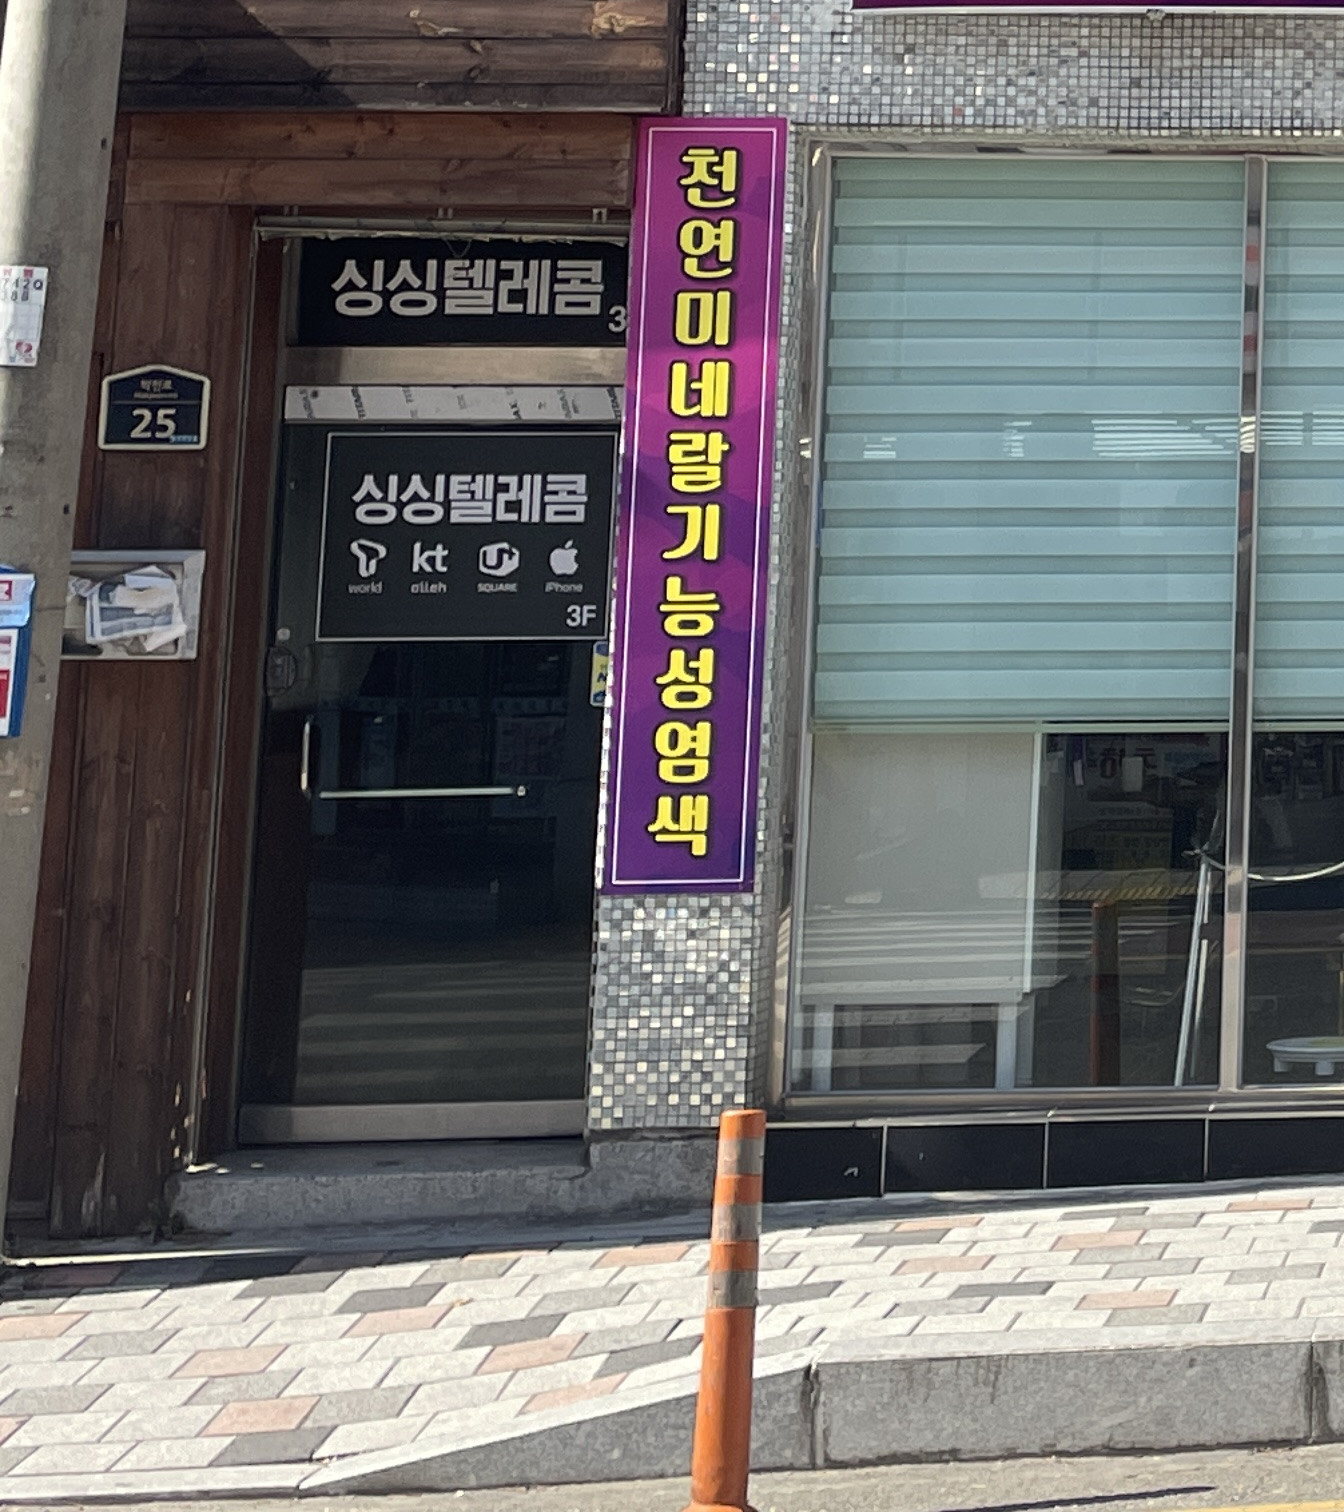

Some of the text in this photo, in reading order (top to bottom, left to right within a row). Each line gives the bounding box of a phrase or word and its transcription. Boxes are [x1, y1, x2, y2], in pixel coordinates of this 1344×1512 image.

[331, 259, 604, 318] 싱싱텔레콤
[130, 408, 176, 439] 25
[351, 473, 588, 525] 싱싱텔레콤
[647, 146, 740, 859] 천연미네랄기능성염색
[411, 541, 449, 573] kt
[348, 581, 383, 595] world
[410, 581, 447, 595] olleh
[545, 582, 584, 594] iPhone
[566, 605, 597, 627] 3F
